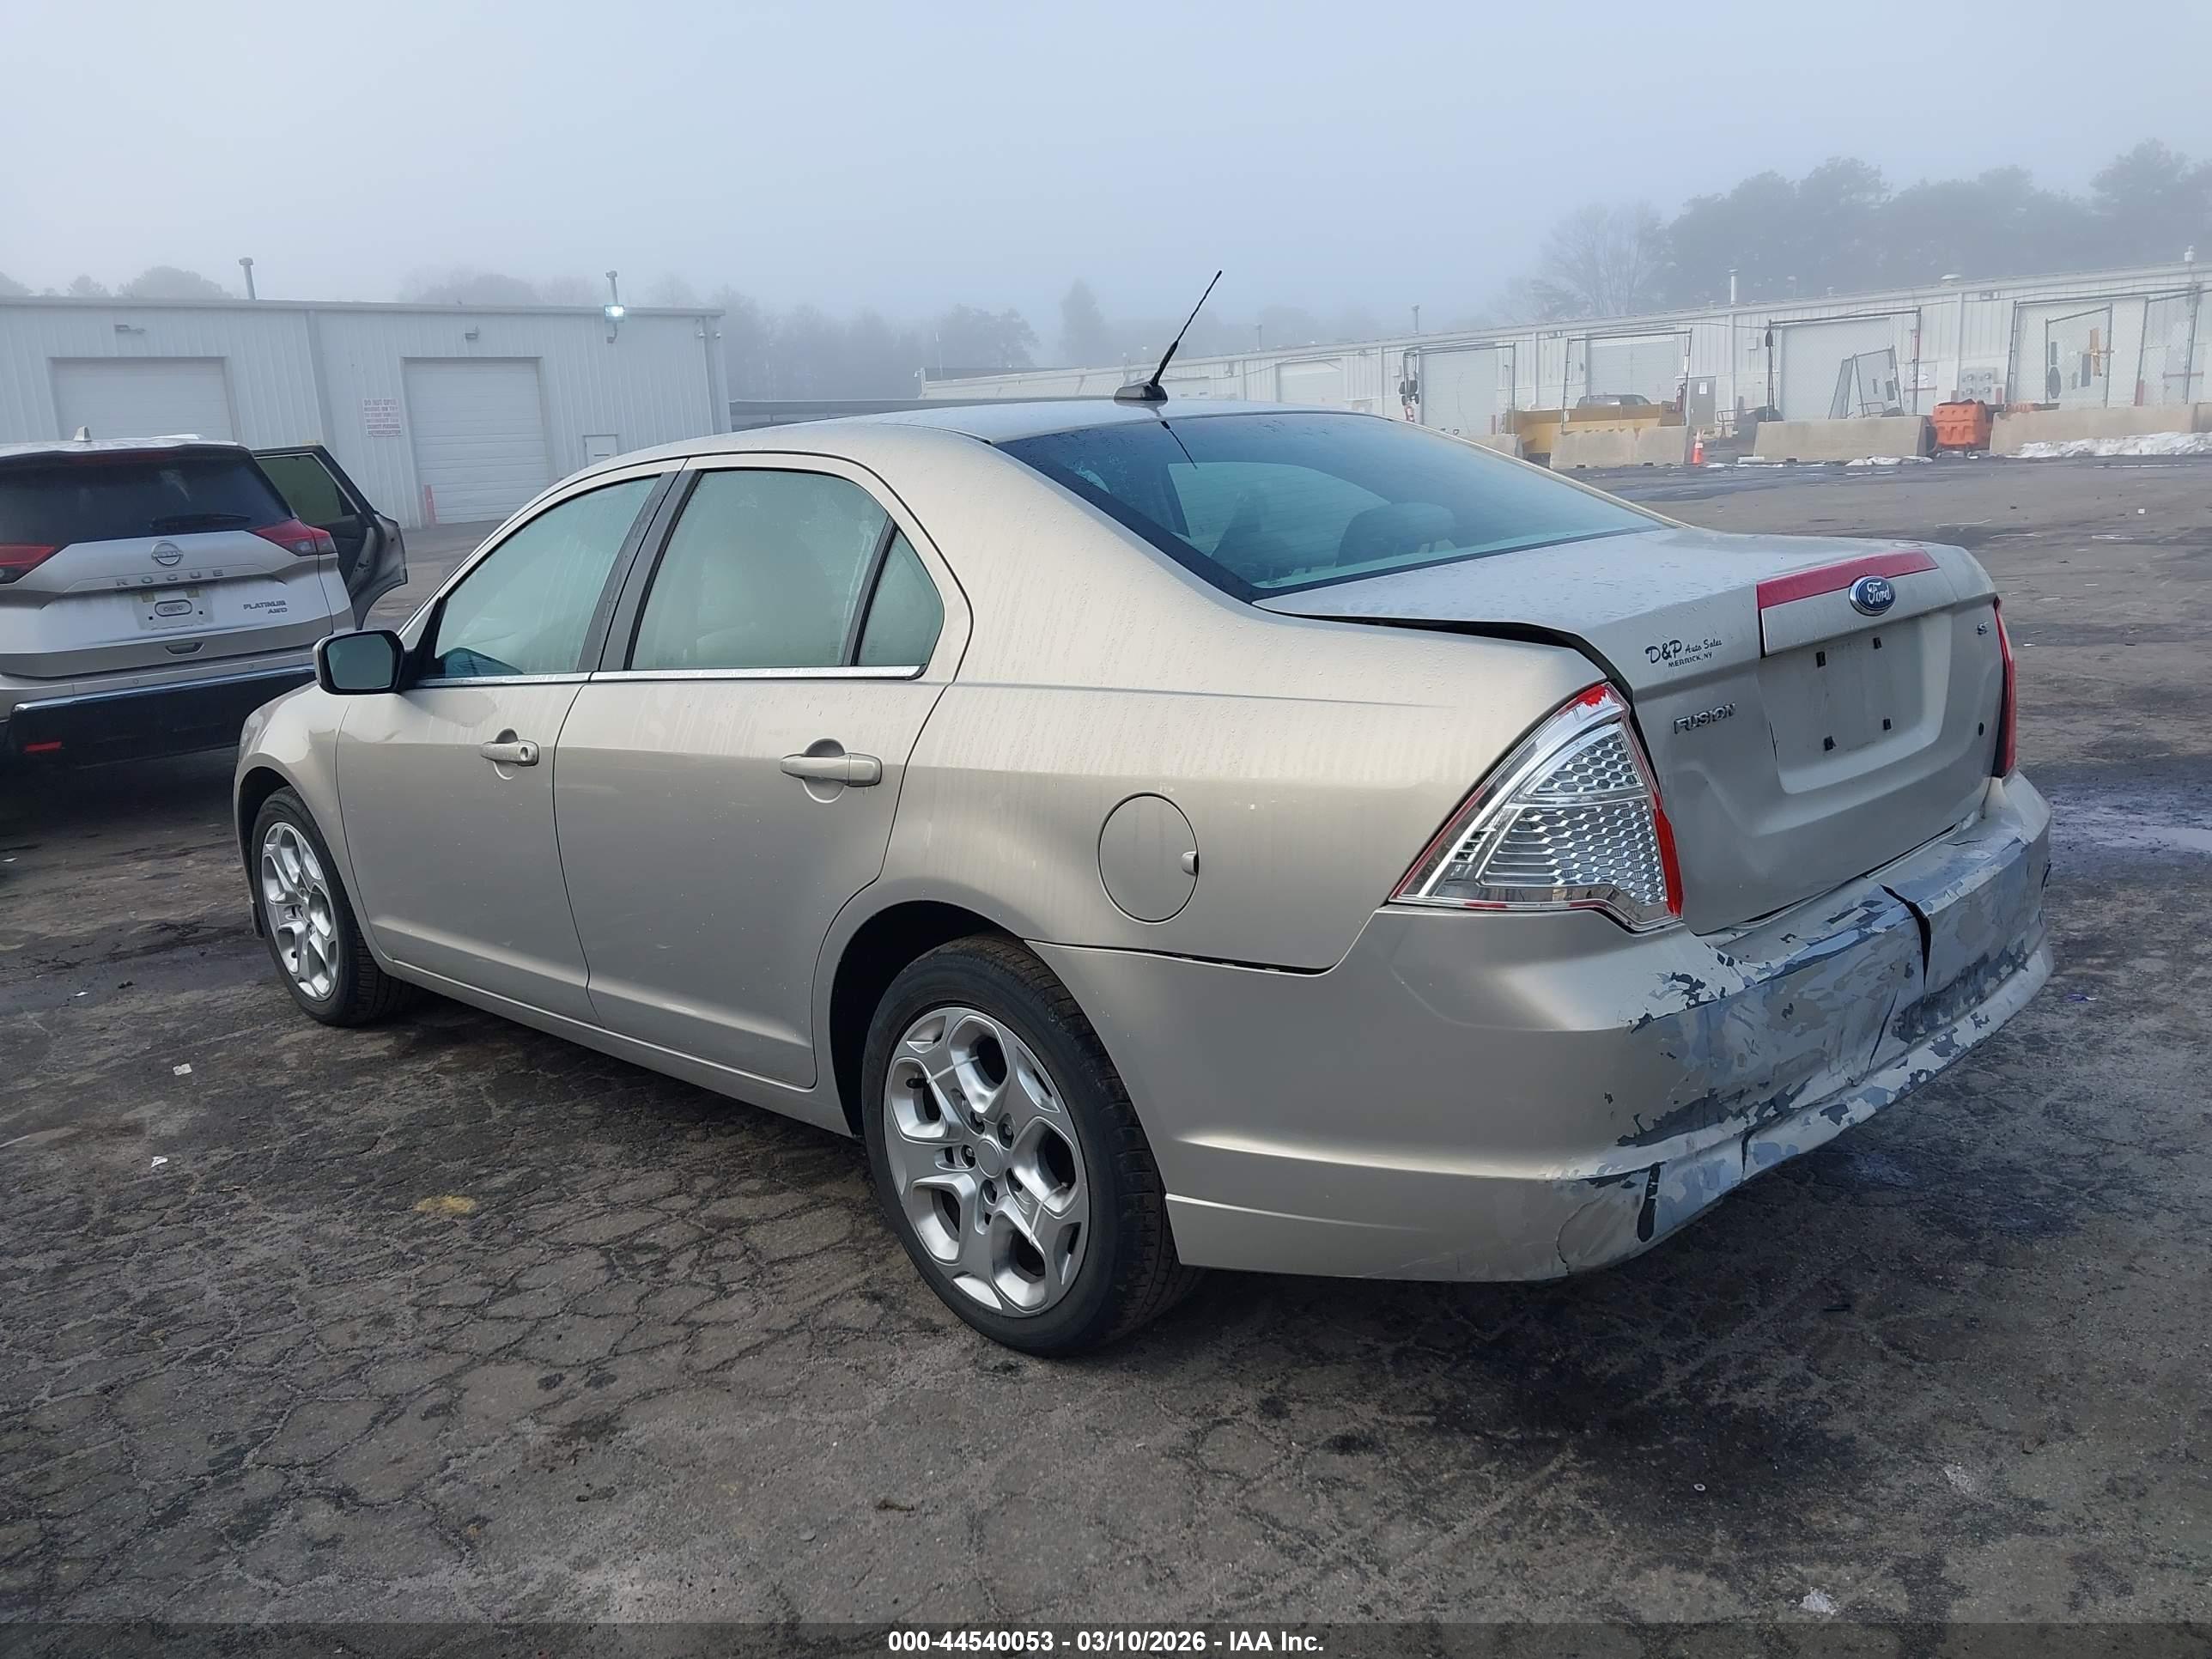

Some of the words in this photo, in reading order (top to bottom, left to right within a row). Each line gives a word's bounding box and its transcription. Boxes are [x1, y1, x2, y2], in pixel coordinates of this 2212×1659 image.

[115, 569, 224, 587] ROGUE
[1866, 581, 1893, 605] Ford
[1644, 639, 1682, 664] D&P
[1685, 643, 1703, 654] Auto
[1703, 638, 1723, 650] Sales
[1673, 702, 1736, 735] FUSION
